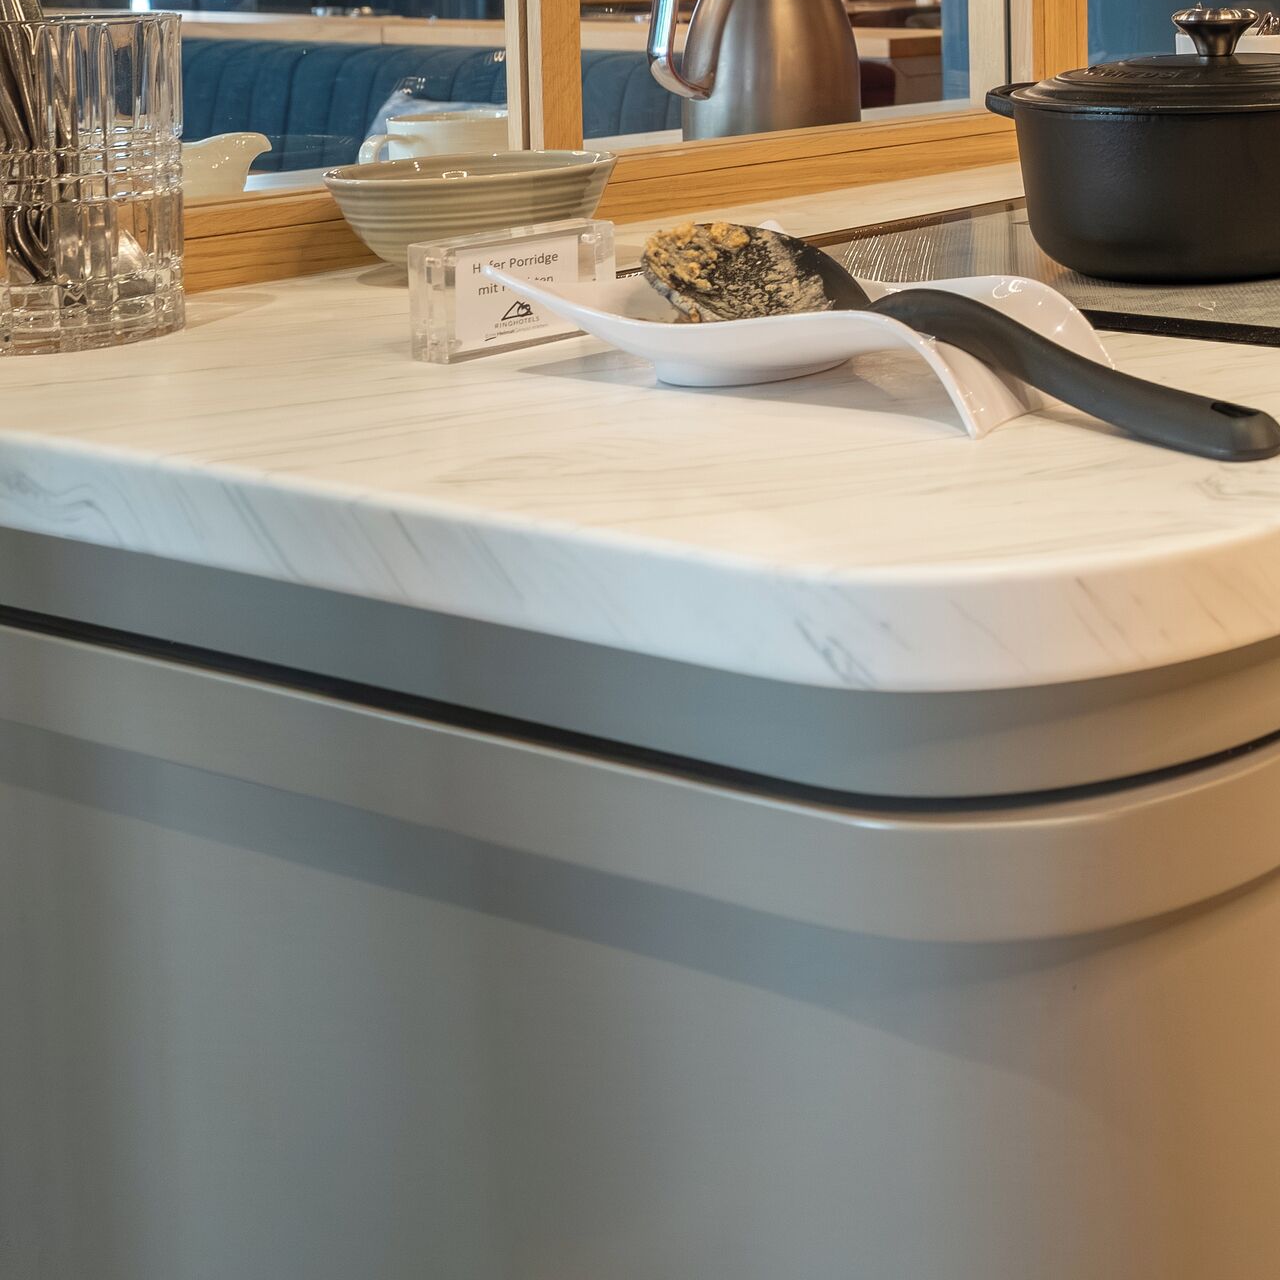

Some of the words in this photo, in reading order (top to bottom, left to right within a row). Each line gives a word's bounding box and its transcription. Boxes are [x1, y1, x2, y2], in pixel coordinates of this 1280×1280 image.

[473, 259, 506, 274] Hfer
[509, 253, 559, 269] Porridge
[478, 283, 499, 296] mit
[494, 316, 540, 329] RINGHOTELS
